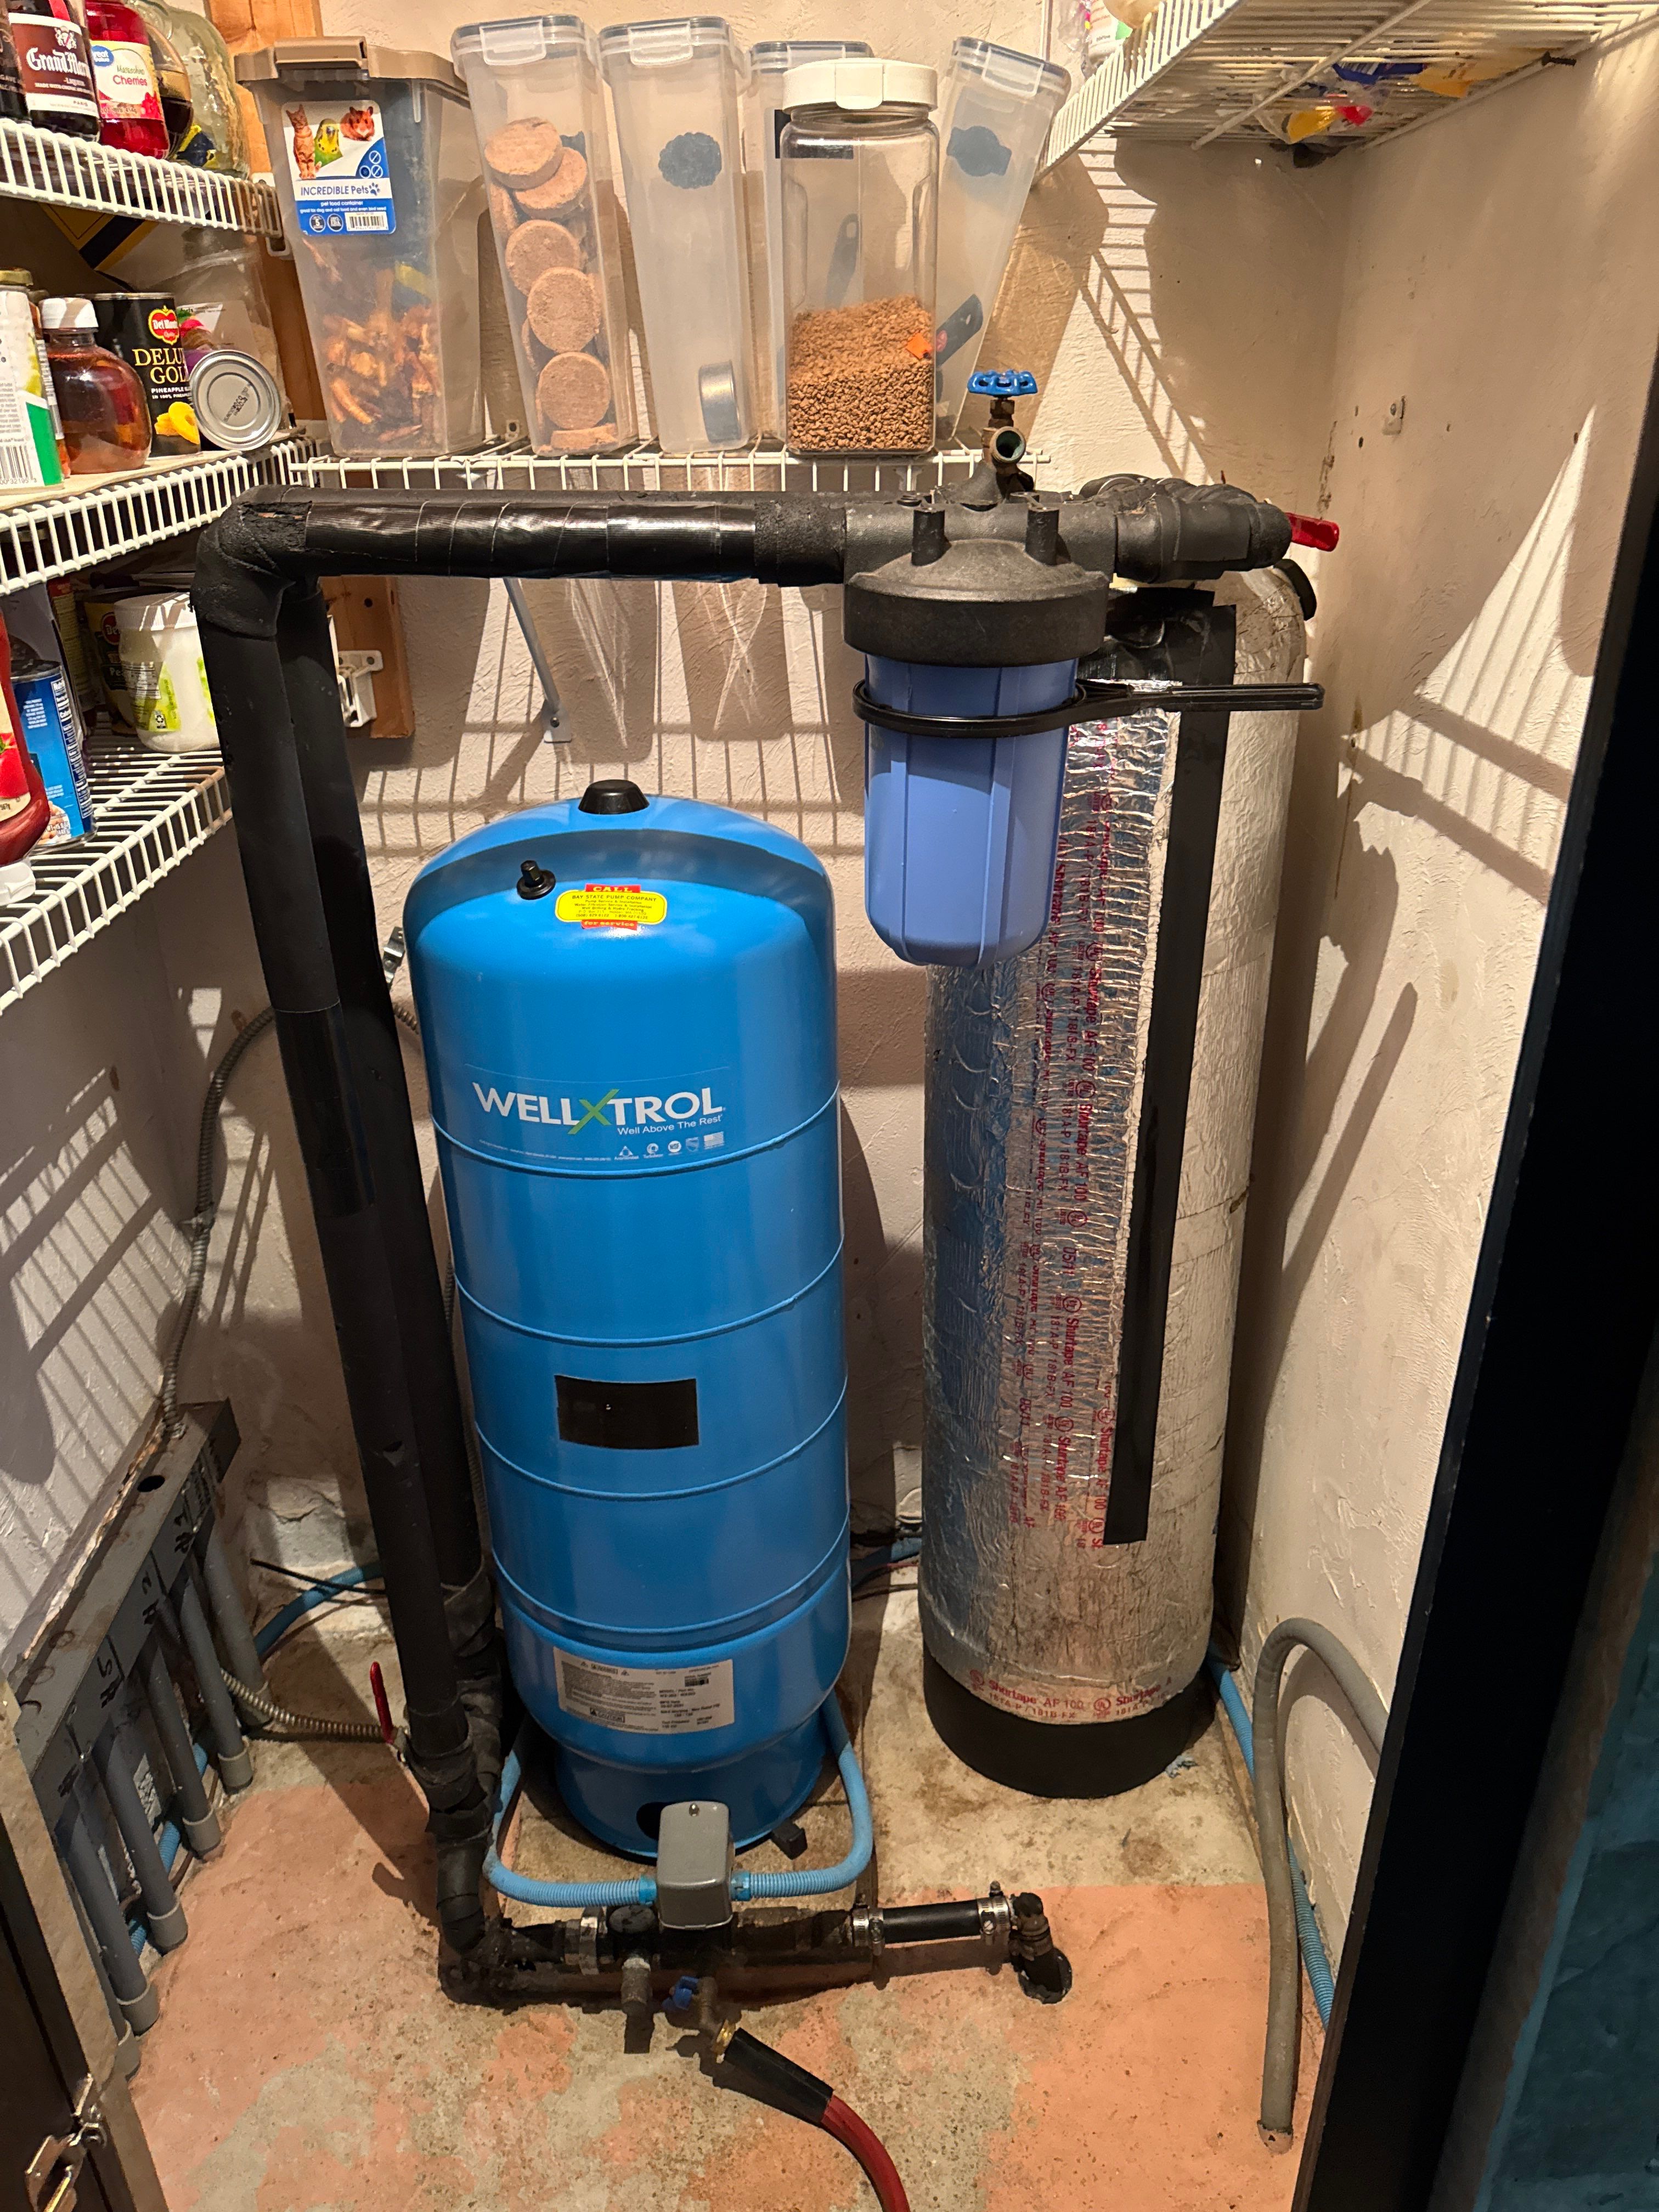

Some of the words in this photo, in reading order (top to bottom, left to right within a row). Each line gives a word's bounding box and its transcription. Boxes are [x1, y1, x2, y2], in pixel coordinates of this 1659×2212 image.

[112, 75, 148, 86] Cherries
[301, 186, 349, 196] INCREDIBLE
[351, 185, 369, 195] Pets
[315, 218, 320, 227] 5
[1066, 1017, 1079, 1062] 181B-FX
[1084, 1030, 1098, 1048] AF
[1082, 1053, 1097, 1071] 100
[642, 1125, 674, 1133] Above
[678, 1121, 696, 1129] The
[699, 1115, 723, 1125] Rest
[1061, 1103, 1073, 1138] 181A-P
[1075, 1104, 1093, 1155] Shurtape
[1058, 1149, 1070, 1192] 181B-FX
[1075, 1161, 1089, 1178] AF
[1074, 1182, 1088, 1201] 100
[1049, 1316, 1060, 1350] 181A-P
[1062, 1317, 1080, 1365] Shurtape
[1045, 1359, 1057, 1397] 181B-FX
[1062, 1372, 1076, 1387] AF
[1060, 1390, 1074, 1408] 100
[1096, 1427, 1113, 1472] Shurtape
[1054, 1436, 1071, 1482] Shurtape
[1056, 1486, 1068, 1501] AF
[1094, 1495, 1107, 1510] 100
[989, 1679, 1037, 1703] Shurtape
[1043, 1697, 1059, 1708] AF
[1064, 1700, 1084, 1710] 100
[1116, 1684, 1161, 1706] Shurtape
[1032, 1707, 1075, 1719] 181B-FX
